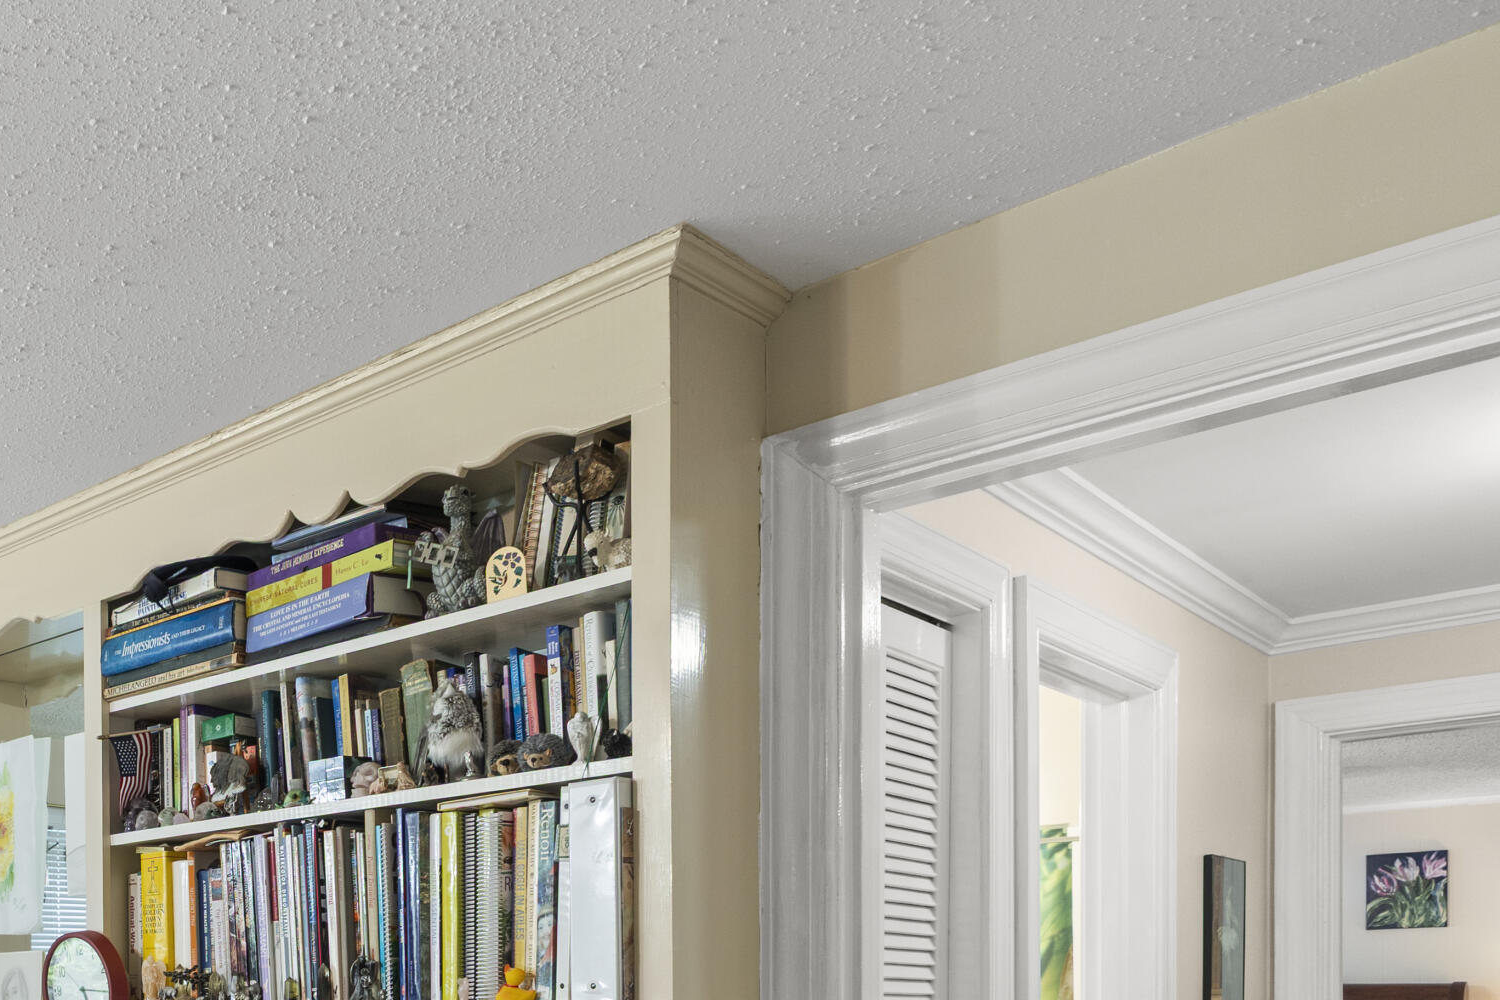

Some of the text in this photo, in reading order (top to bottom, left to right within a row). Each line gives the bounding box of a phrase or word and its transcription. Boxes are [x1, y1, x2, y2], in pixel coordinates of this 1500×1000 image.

[271, 564, 280, 575] THE
[314, 539, 344, 559] EXPERIENCE
[300, 577, 318, 587] CURES
[270, 607, 284, 618] LOVE
[298, 598, 309, 608] THE
[310, 591, 330, 604] EARTH
[312, 593, 350, 613] ENCYCLOPEDIA
[121, 631, 171, 659] Impressionists
[107, 677, 156, 698] MICHELANGELO
[157, 673, 168, 682] and
[540, 807, 554, 862] Renoir
[516, 840, 525, 941] VAN GOGH IN ARLES
